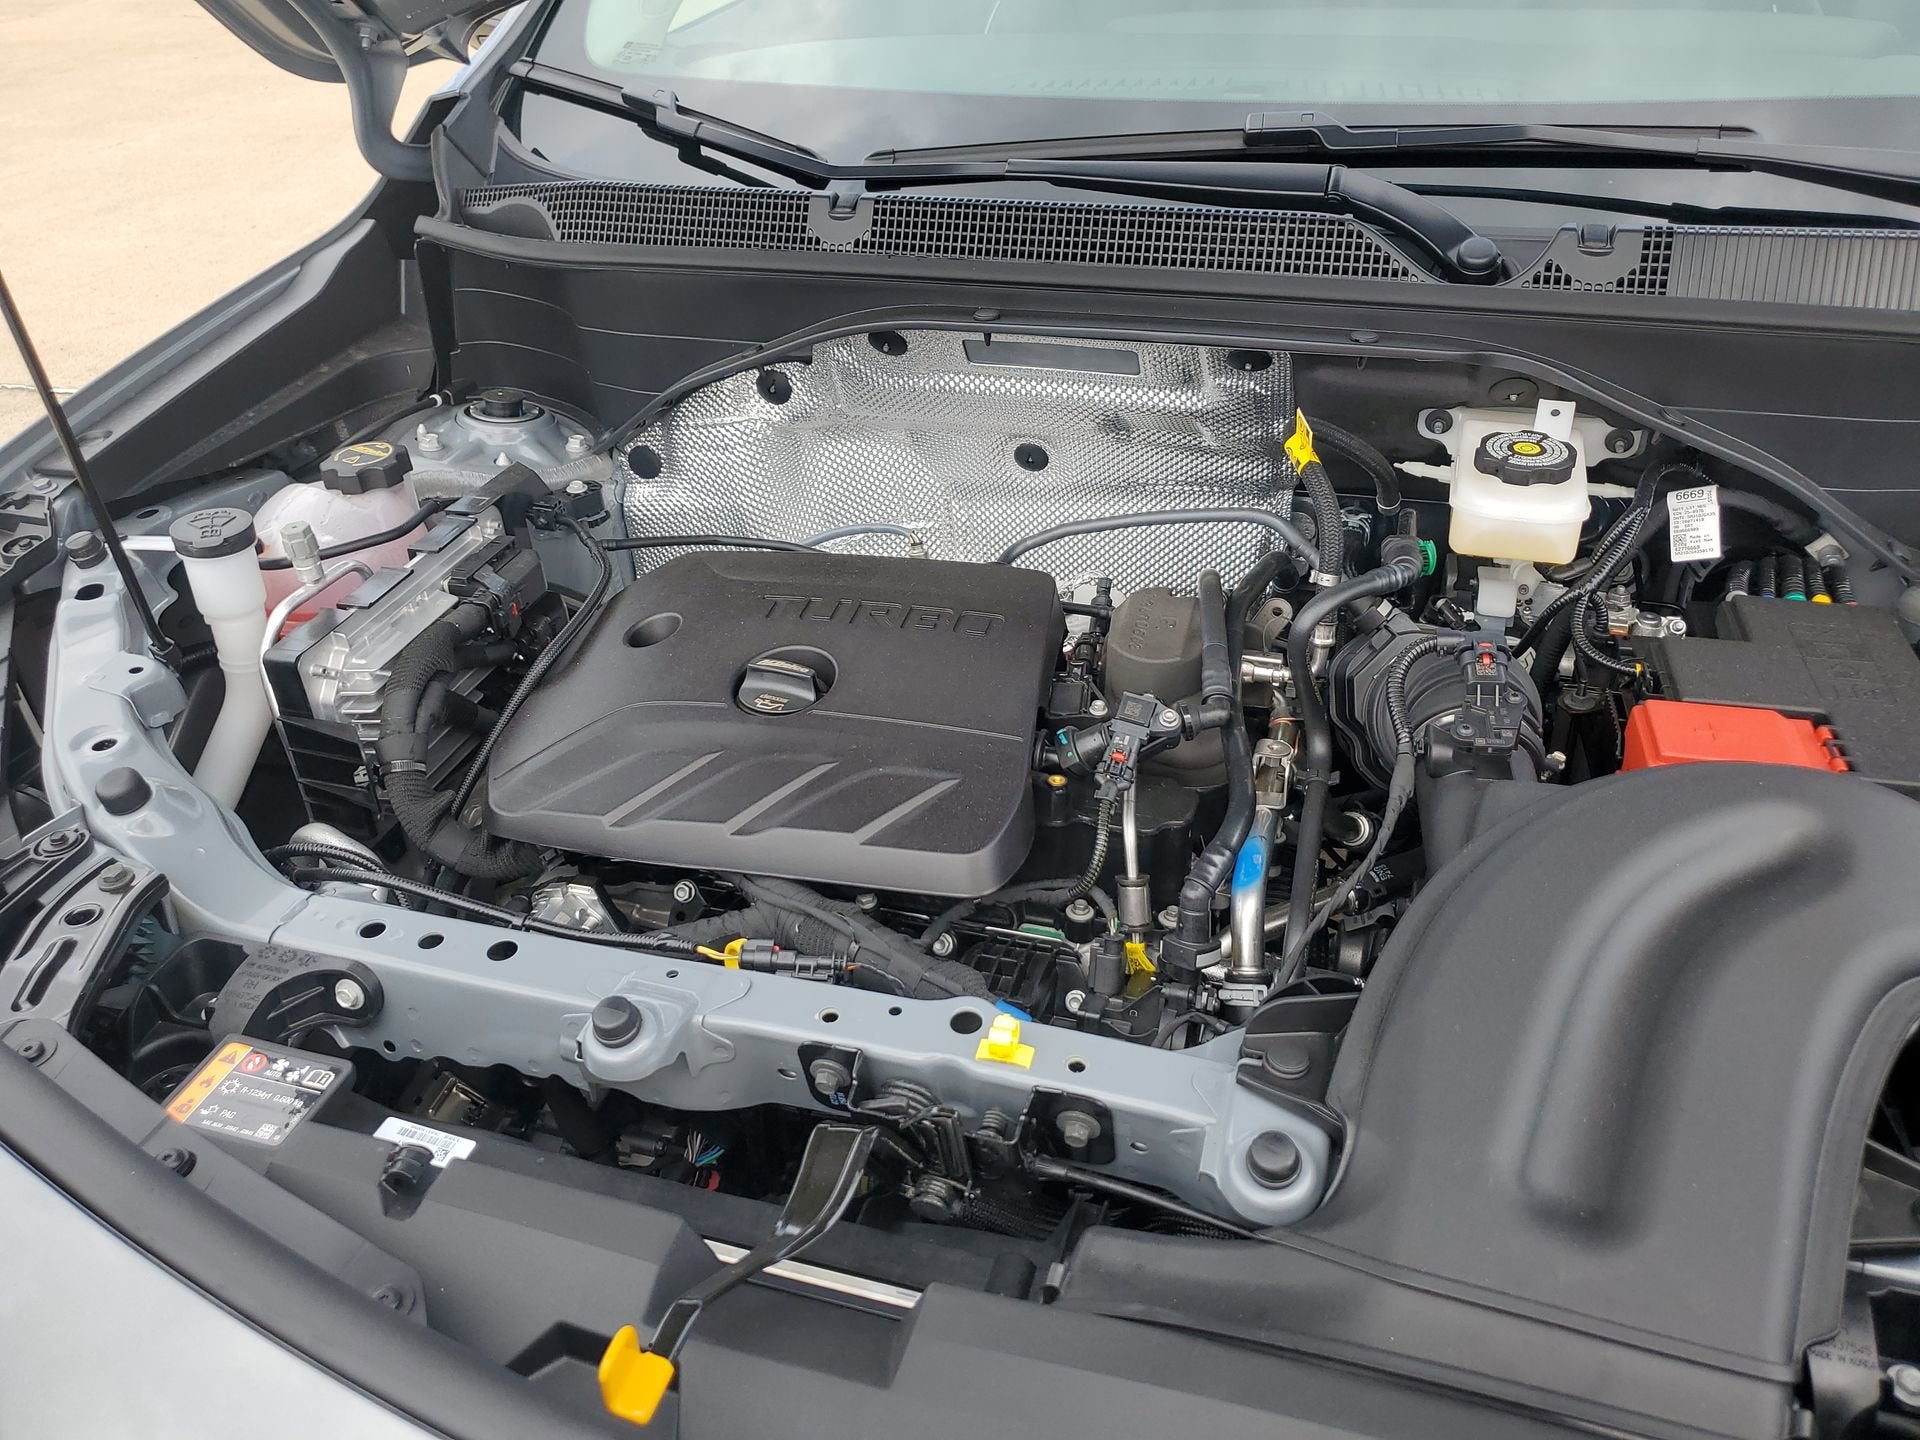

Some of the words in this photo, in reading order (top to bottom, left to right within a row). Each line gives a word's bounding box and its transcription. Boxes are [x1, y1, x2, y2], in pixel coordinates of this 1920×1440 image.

[1675, 489, 1704, 501] 6669
[763, 594, 1006, 639] TURBO
[264, 1069, 282, 1078] AUTO
[219, 1109, 237, 1119] PAG
